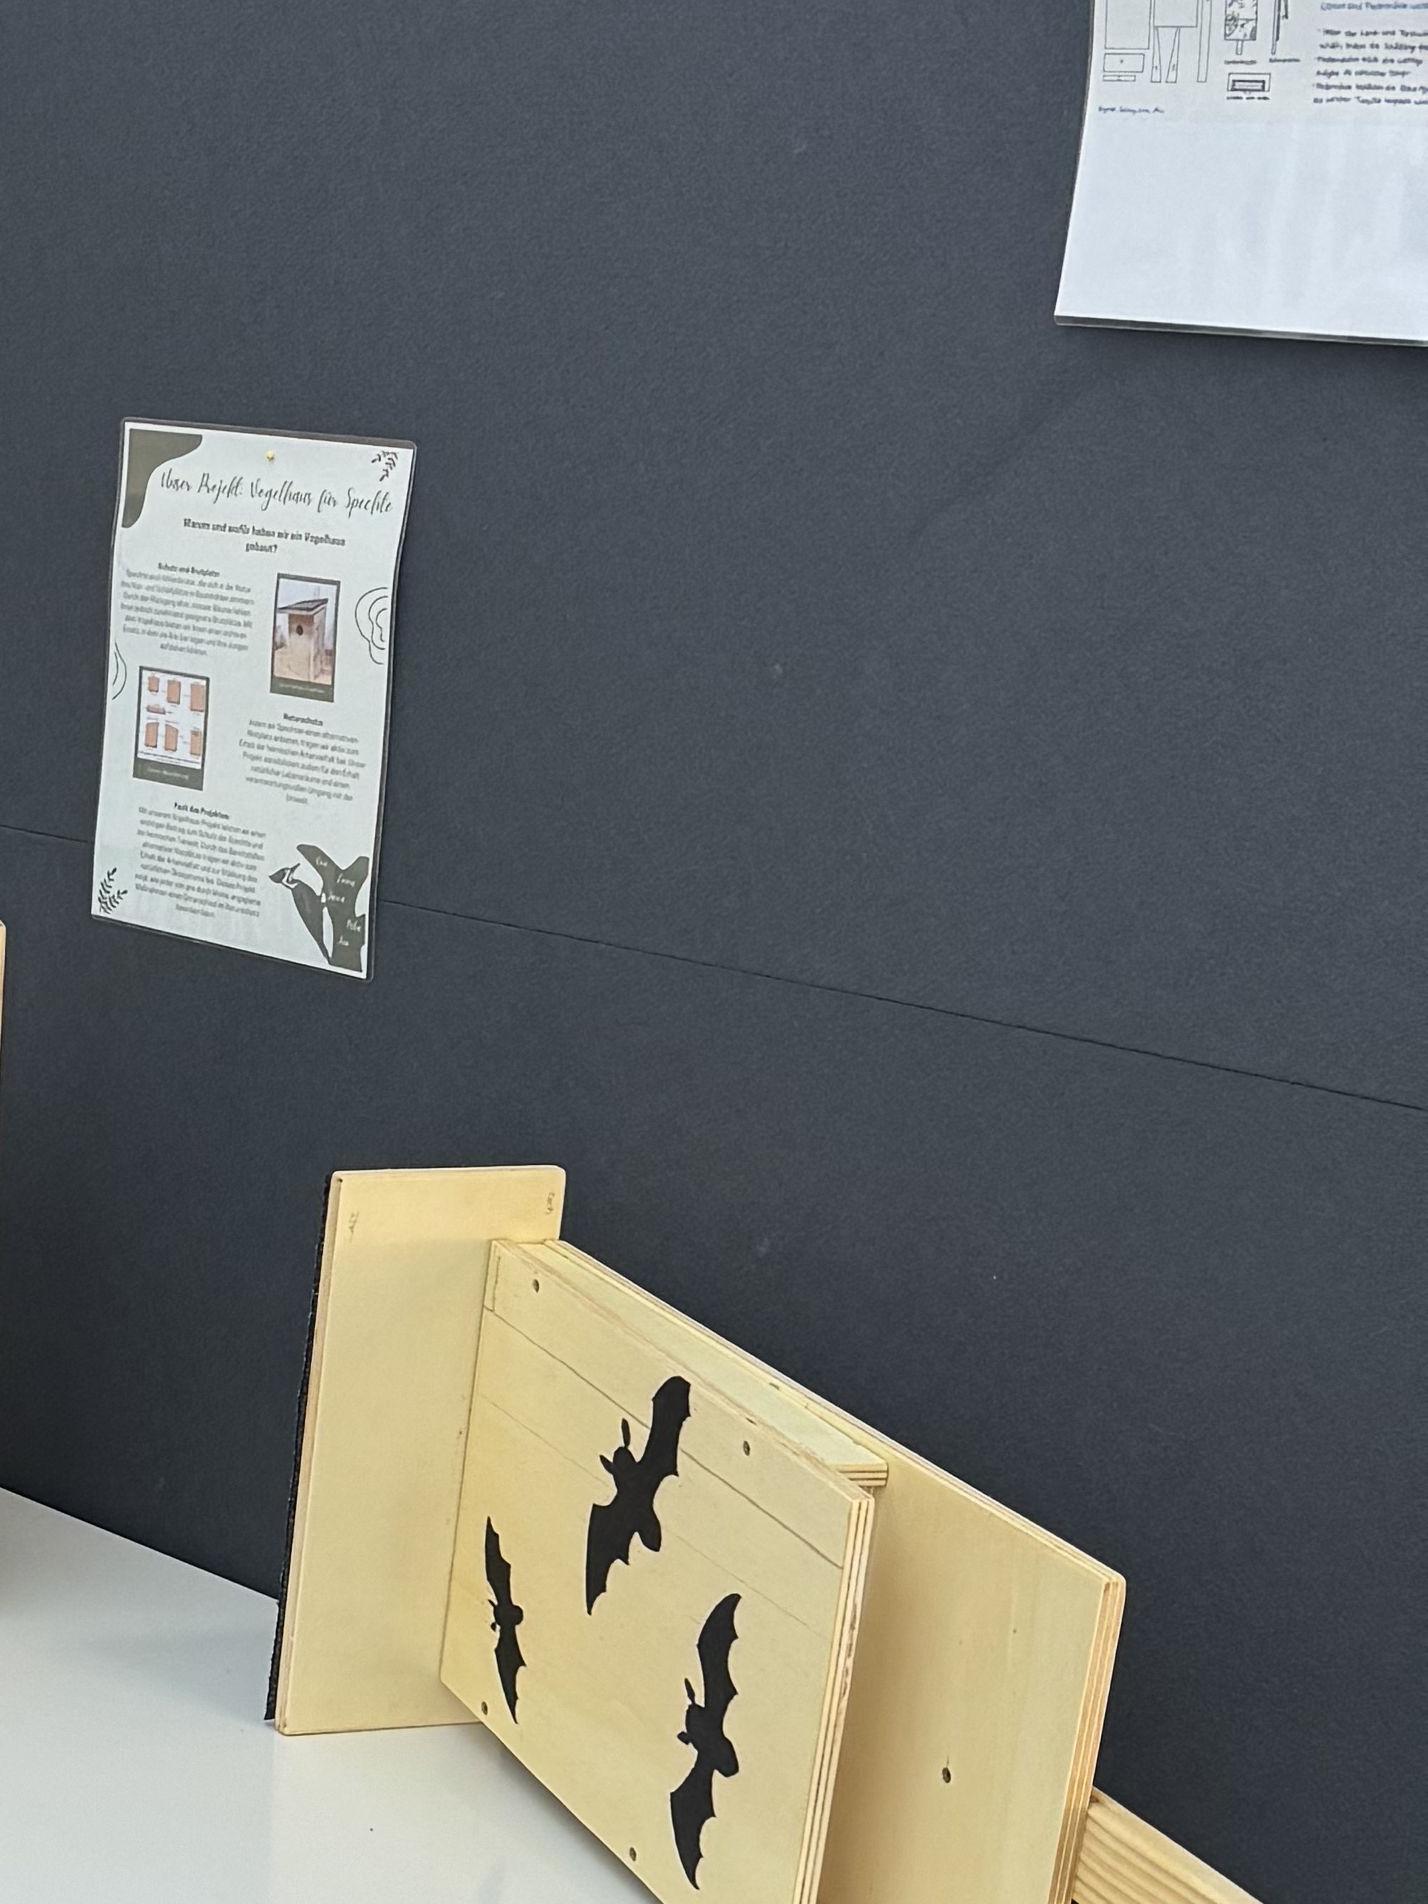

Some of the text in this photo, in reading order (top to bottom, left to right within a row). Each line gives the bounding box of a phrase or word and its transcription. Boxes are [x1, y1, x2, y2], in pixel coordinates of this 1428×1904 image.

[249, 477, 313, 512] Vogelhaus
[317, 487, 338, 514] für
[346, 486, 393, 518] Spechte
